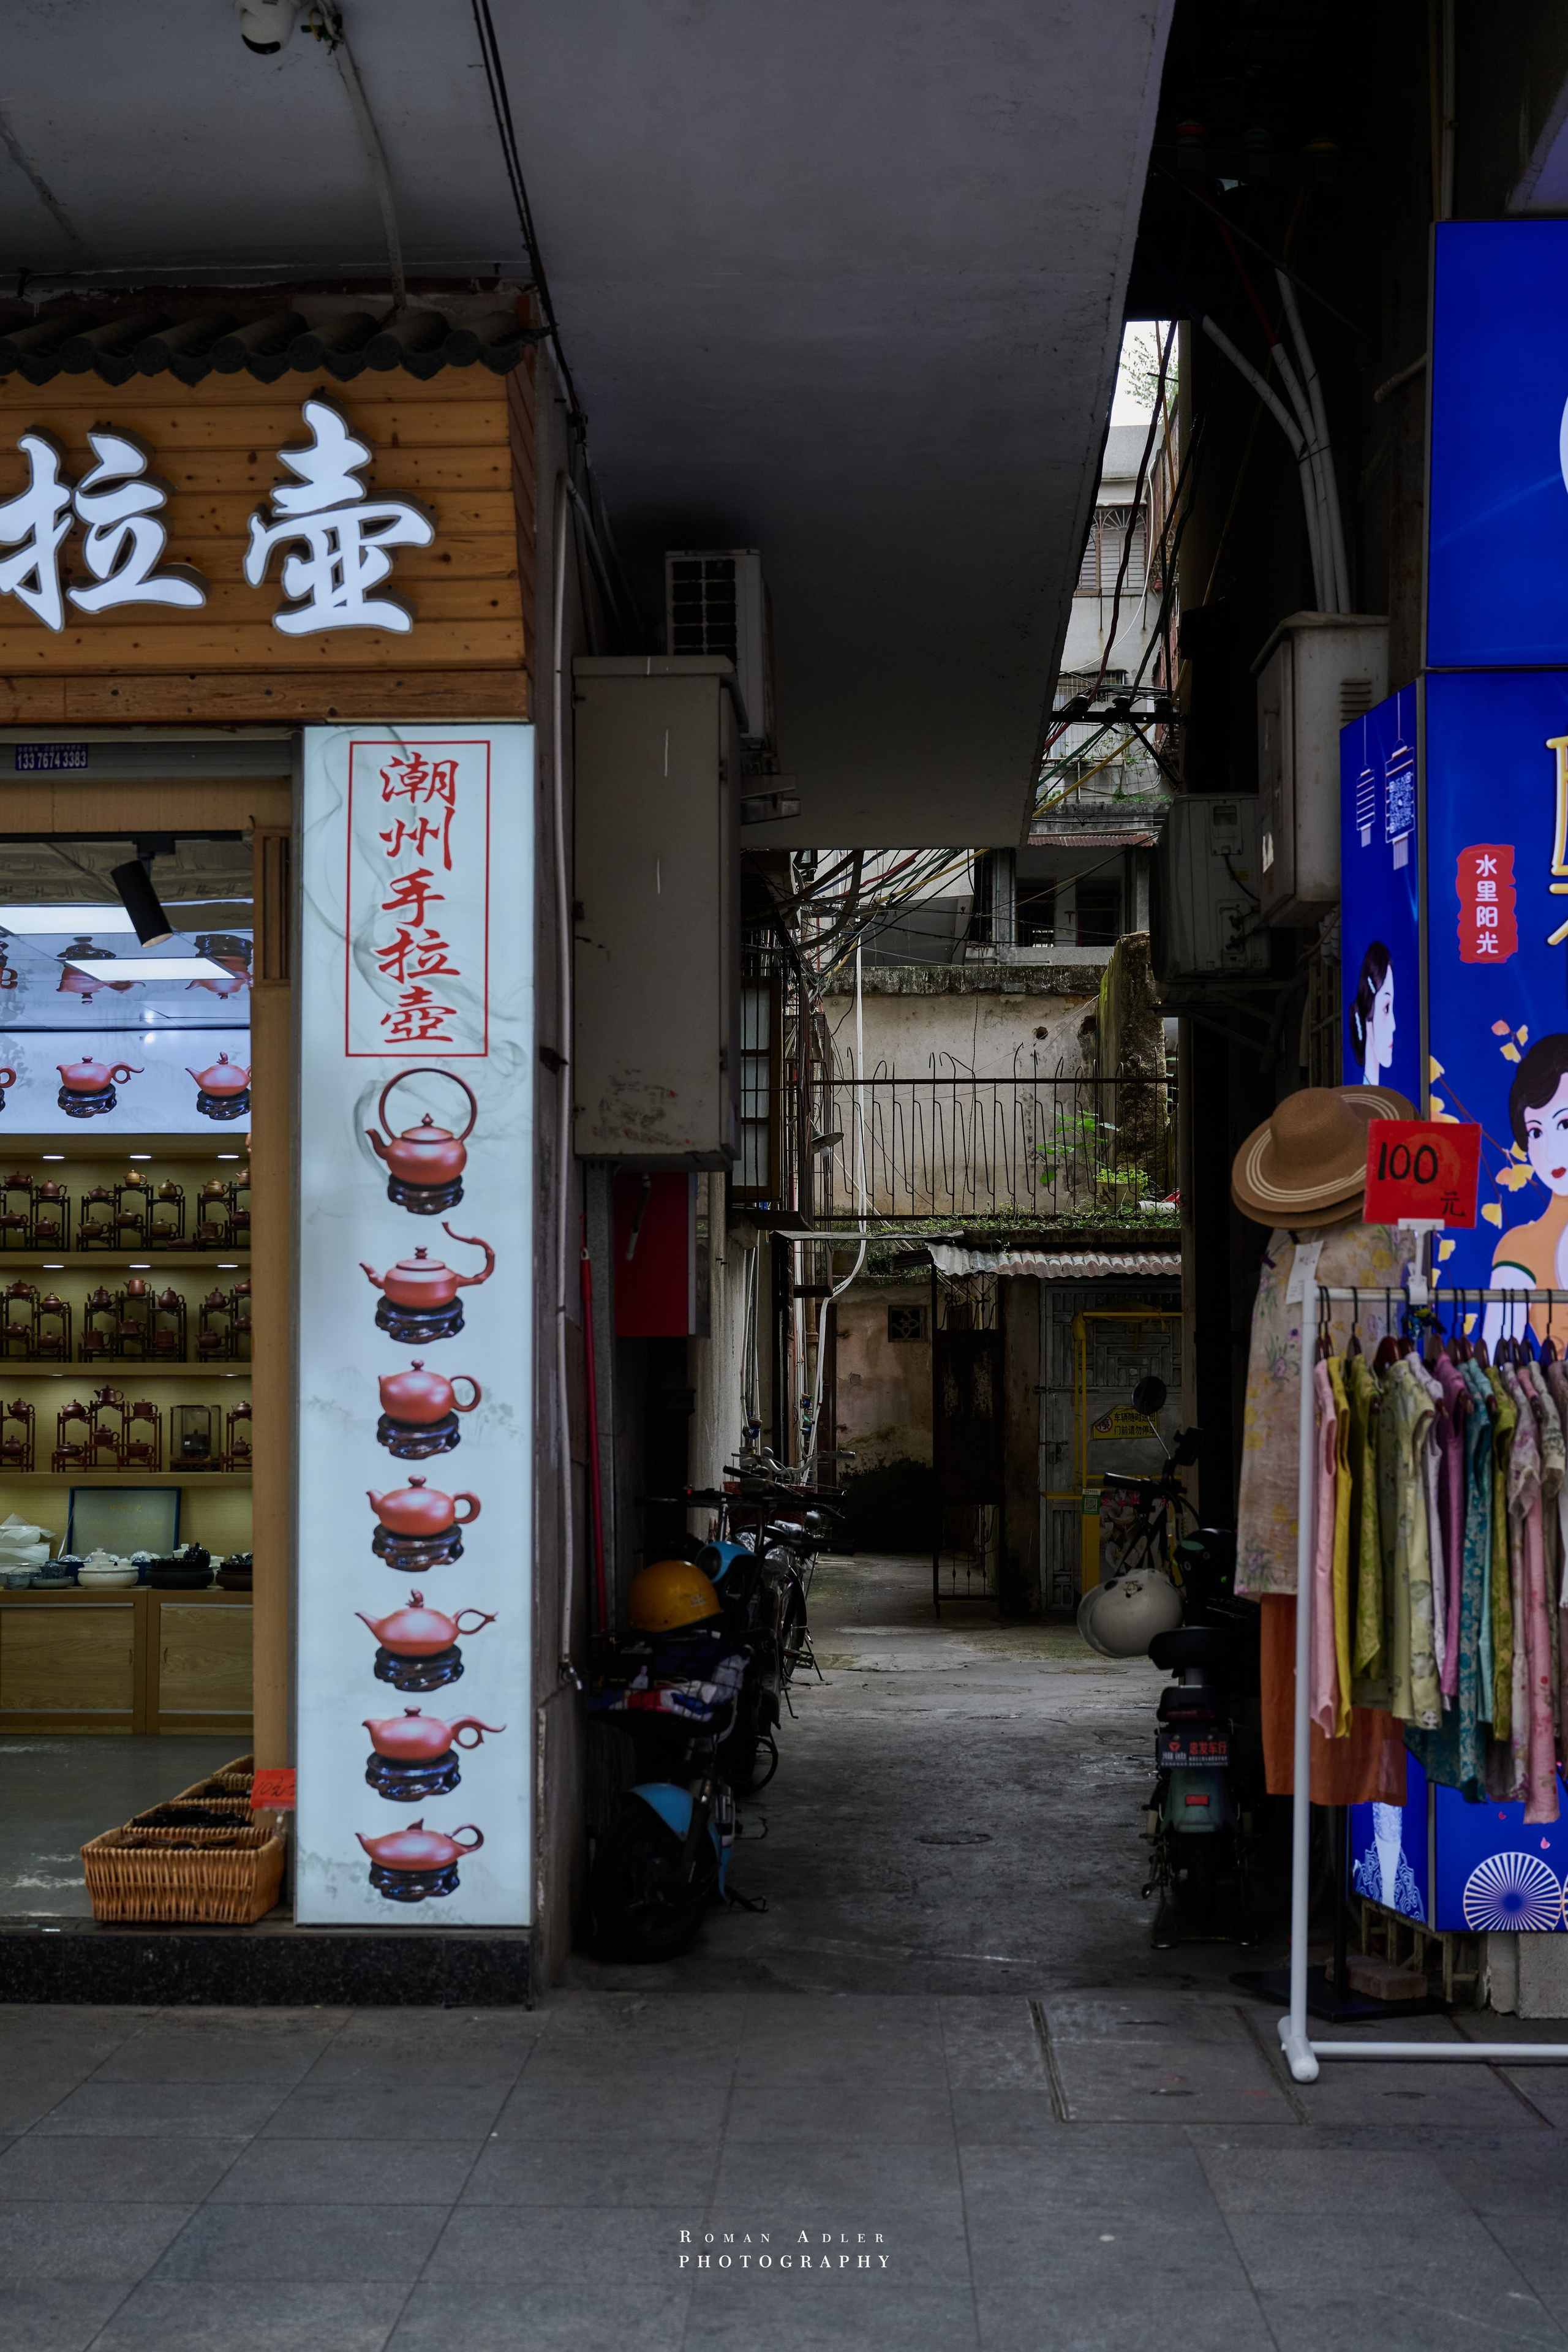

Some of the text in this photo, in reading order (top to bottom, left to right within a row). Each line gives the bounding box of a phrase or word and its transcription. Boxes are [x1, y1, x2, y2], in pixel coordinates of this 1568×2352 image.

[17, 751, 86, 769] 133 7674 3383
[1475, 854, 1498, 954] 水里阳光
[1378, 1142, 1438, 1184] 100
[1440, 1191, 1466, 1216] 元
